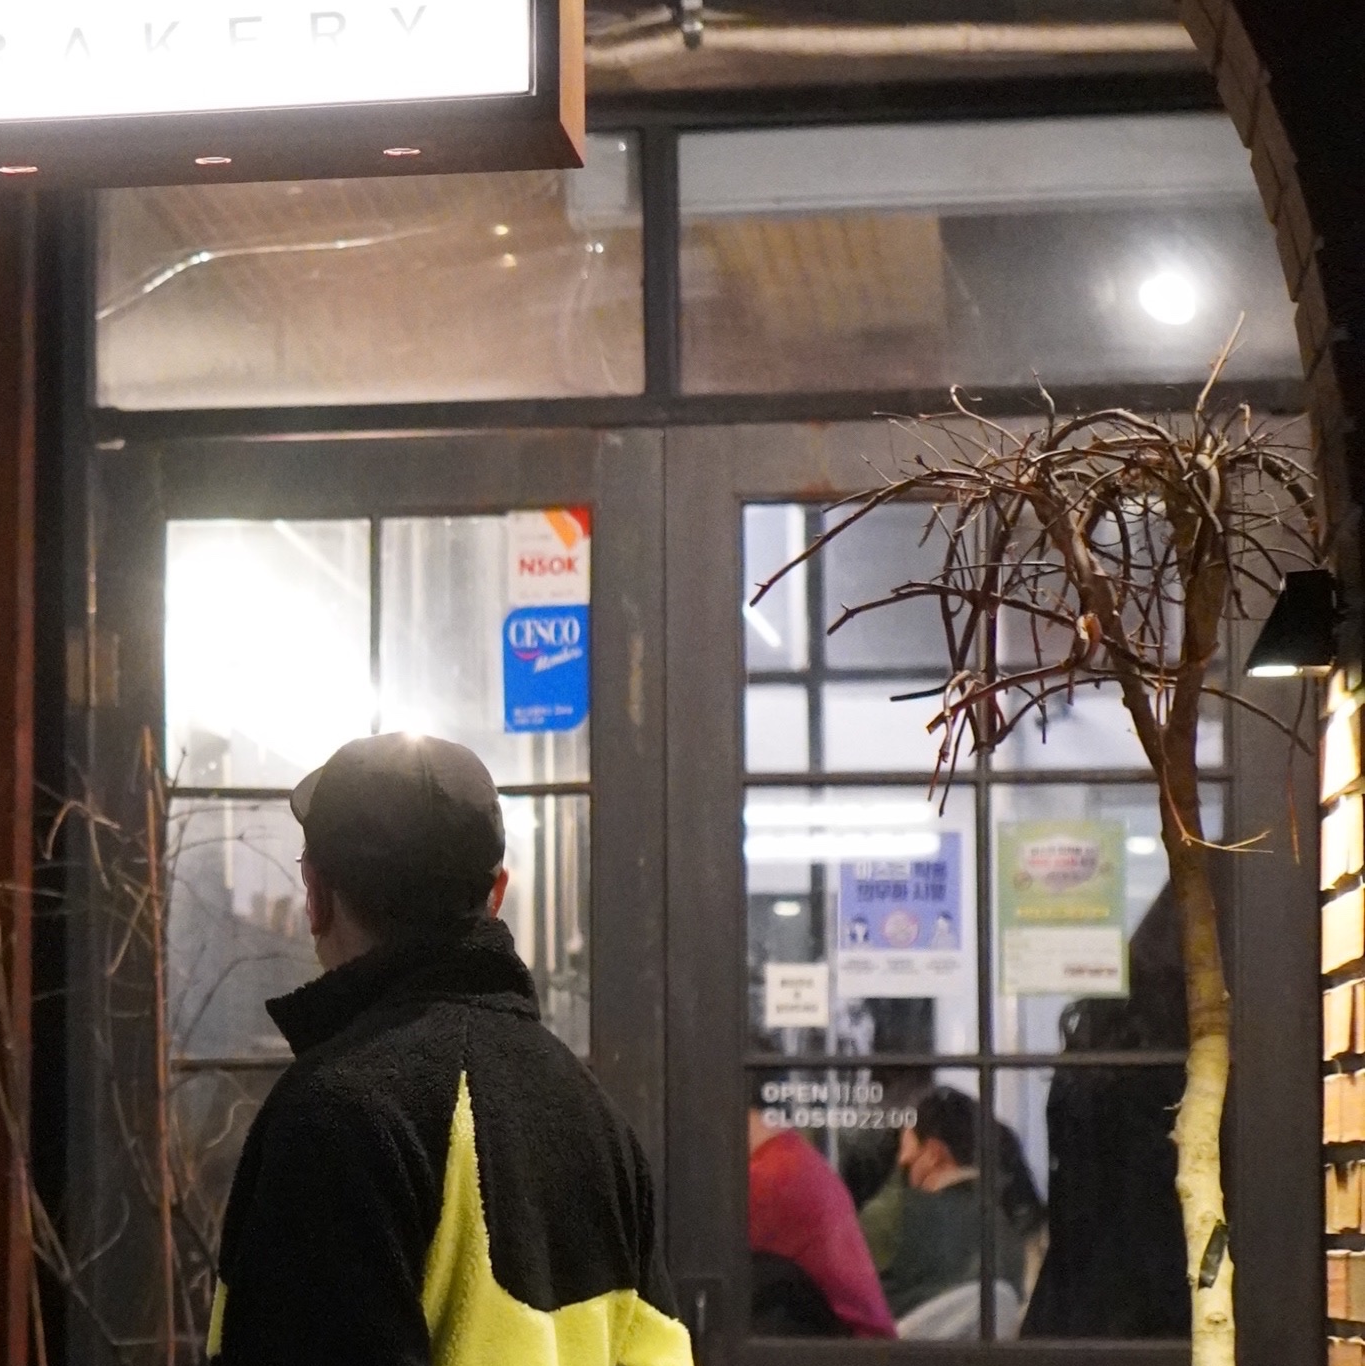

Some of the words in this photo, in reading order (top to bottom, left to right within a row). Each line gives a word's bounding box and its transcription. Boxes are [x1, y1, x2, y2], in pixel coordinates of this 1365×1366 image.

[518, 556, 579, 576] NSOK
[508, 616, 582, 649] CESCO
[761, 1082, 828, 1103] OPEN
[762, 1107, 857, 1129] CLOSED
[858, 1107, 918, 1130] 22:00
